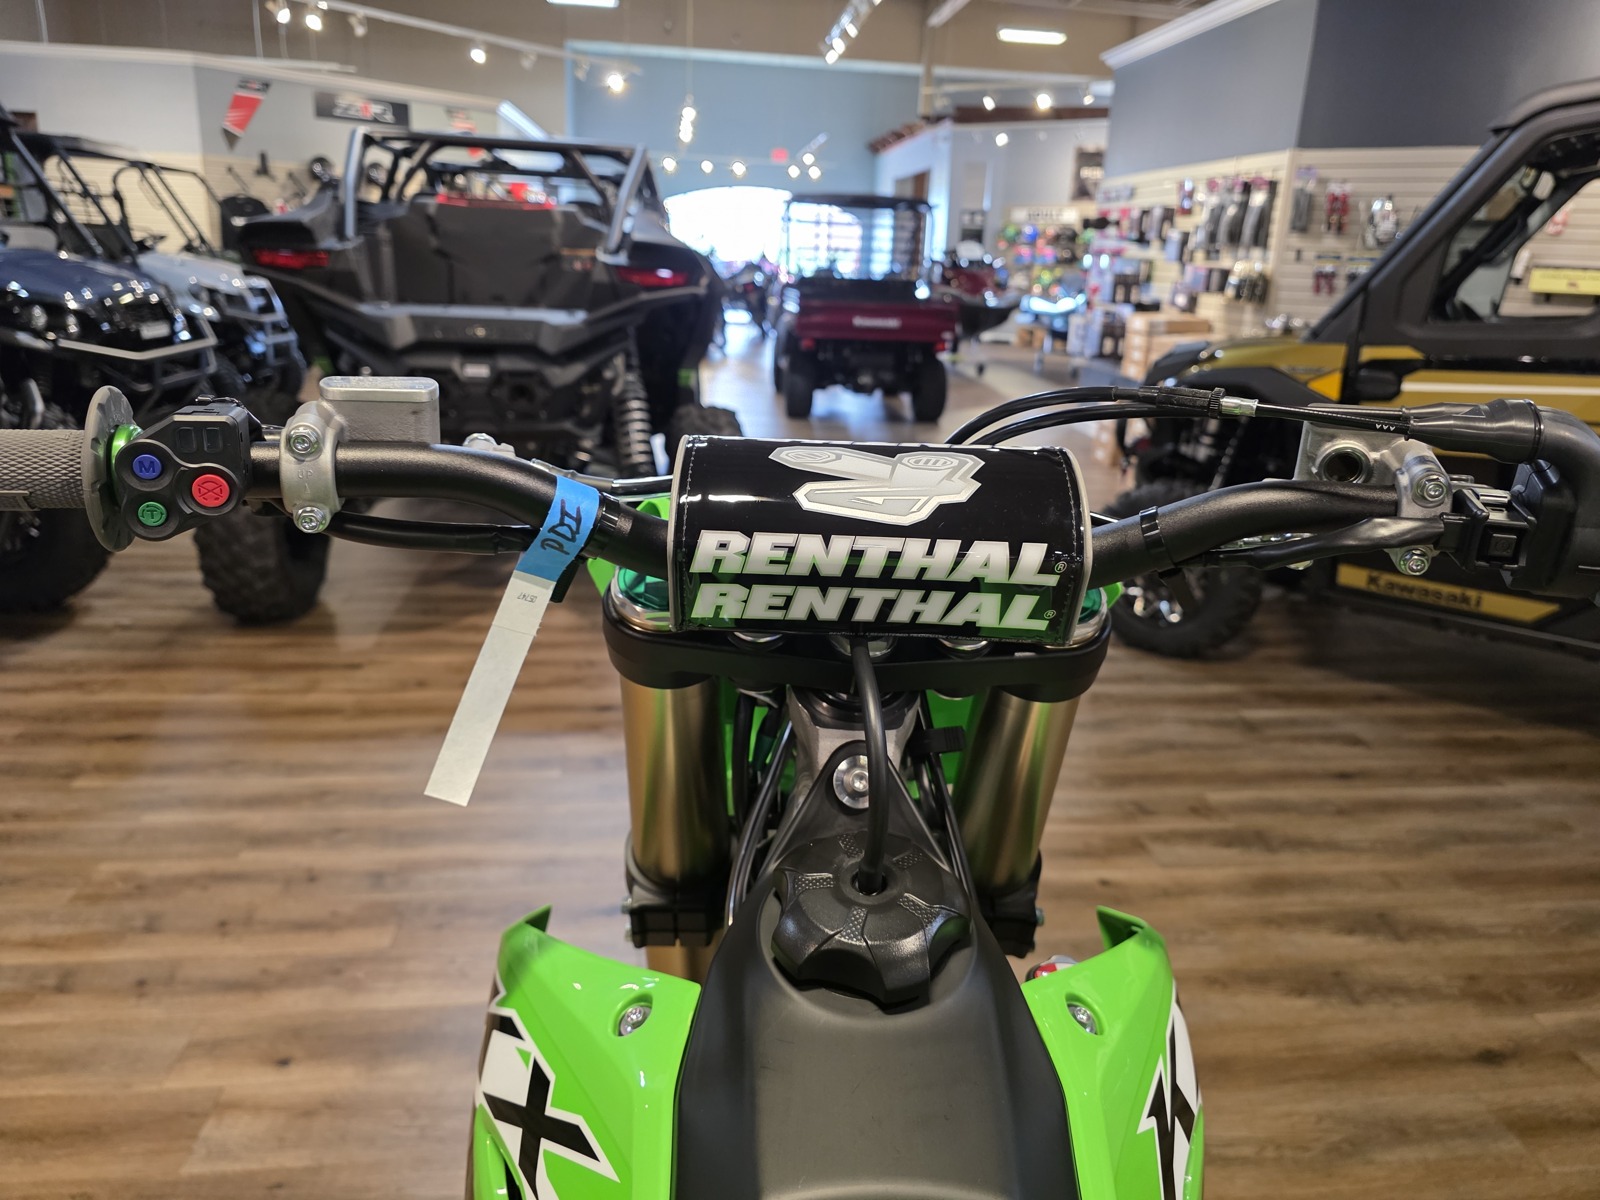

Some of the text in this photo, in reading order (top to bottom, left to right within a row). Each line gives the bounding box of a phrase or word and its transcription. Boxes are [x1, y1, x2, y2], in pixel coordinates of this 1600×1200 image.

[138, 460, 156, 475] M
[298, 469, 314, 479] UP
[541, 498, 582, 555] PDI
[690, 530, 1058, 587] RENTHAL
[691, 583, 1053, 631] RENTHAL
[1366, 571, 1482, 609] Kawasaki
